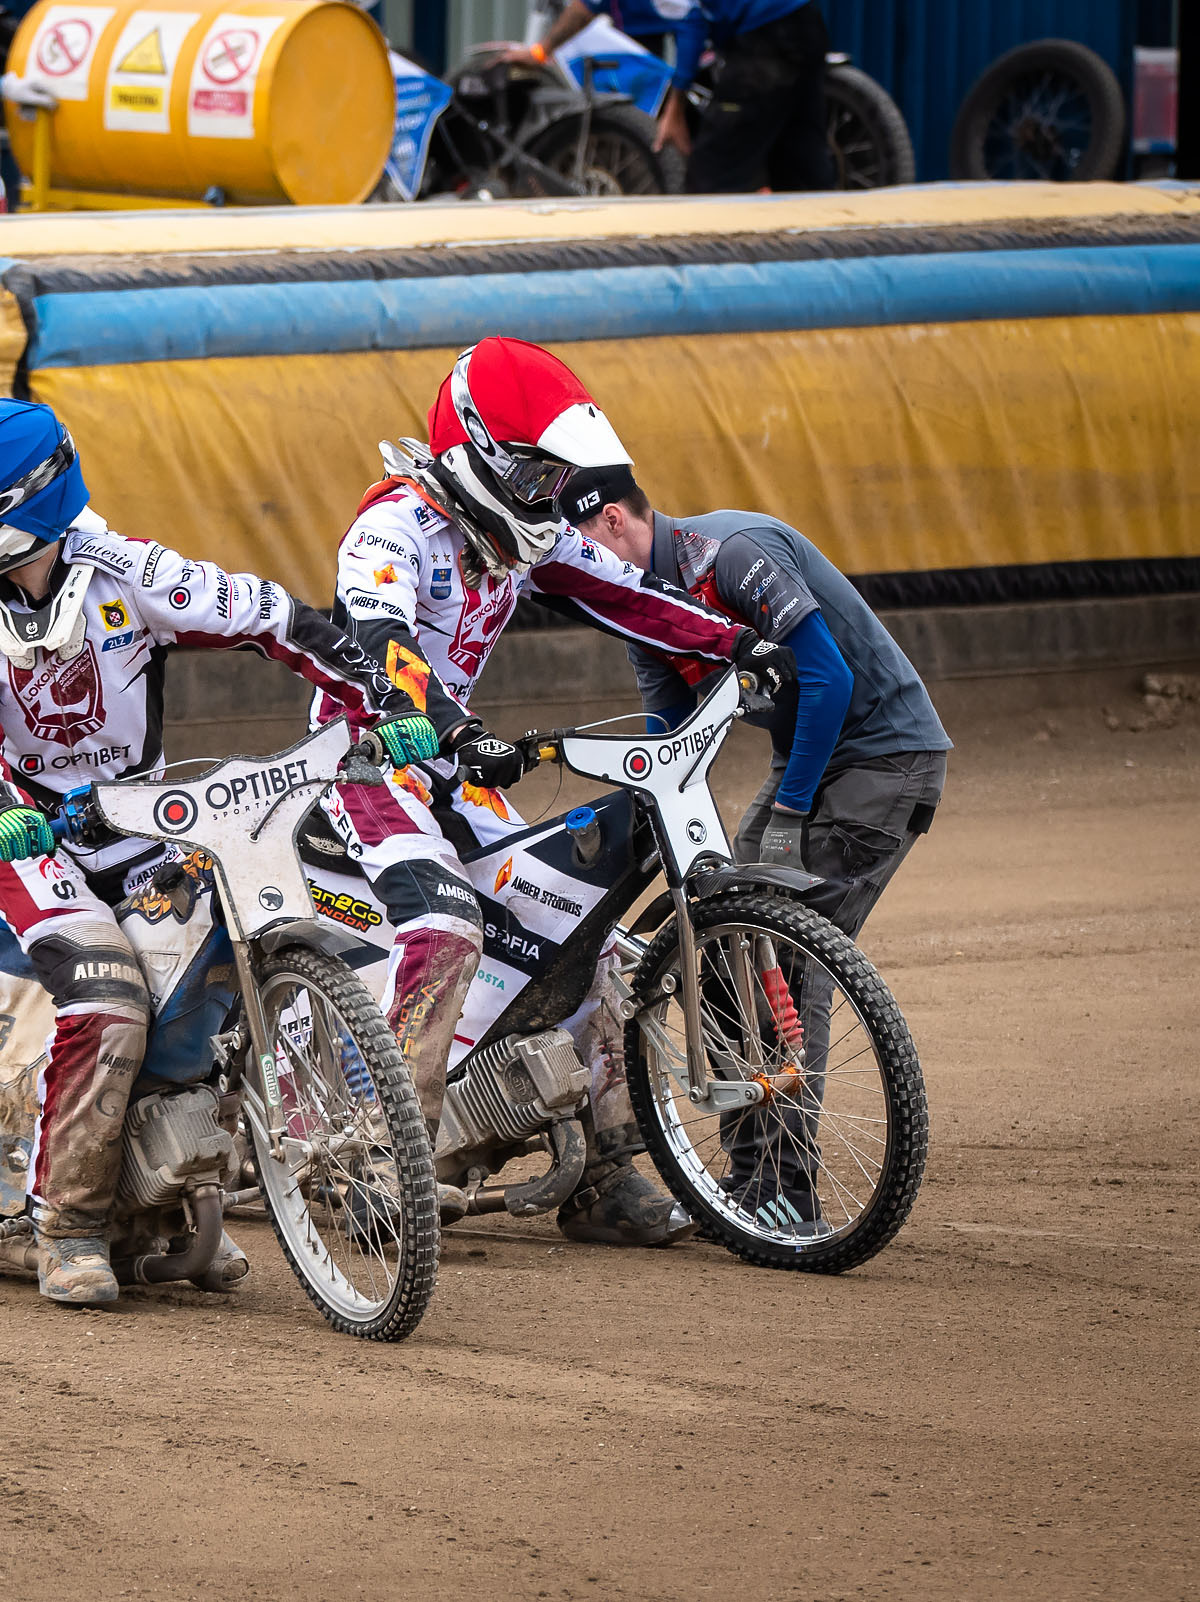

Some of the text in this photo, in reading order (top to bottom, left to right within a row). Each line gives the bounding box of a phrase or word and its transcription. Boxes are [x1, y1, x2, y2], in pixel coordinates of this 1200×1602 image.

[577, 490, 600, 512] 113
[739, 558, 765, 590] TRODO
[51, 745, 131, 769] OPTIBET
[657, 724, 717, 766] OPTIBET
[205, 759, 308, 810] OPTIBET
[511, 876, 583, 917] AMBER STUDIOS
